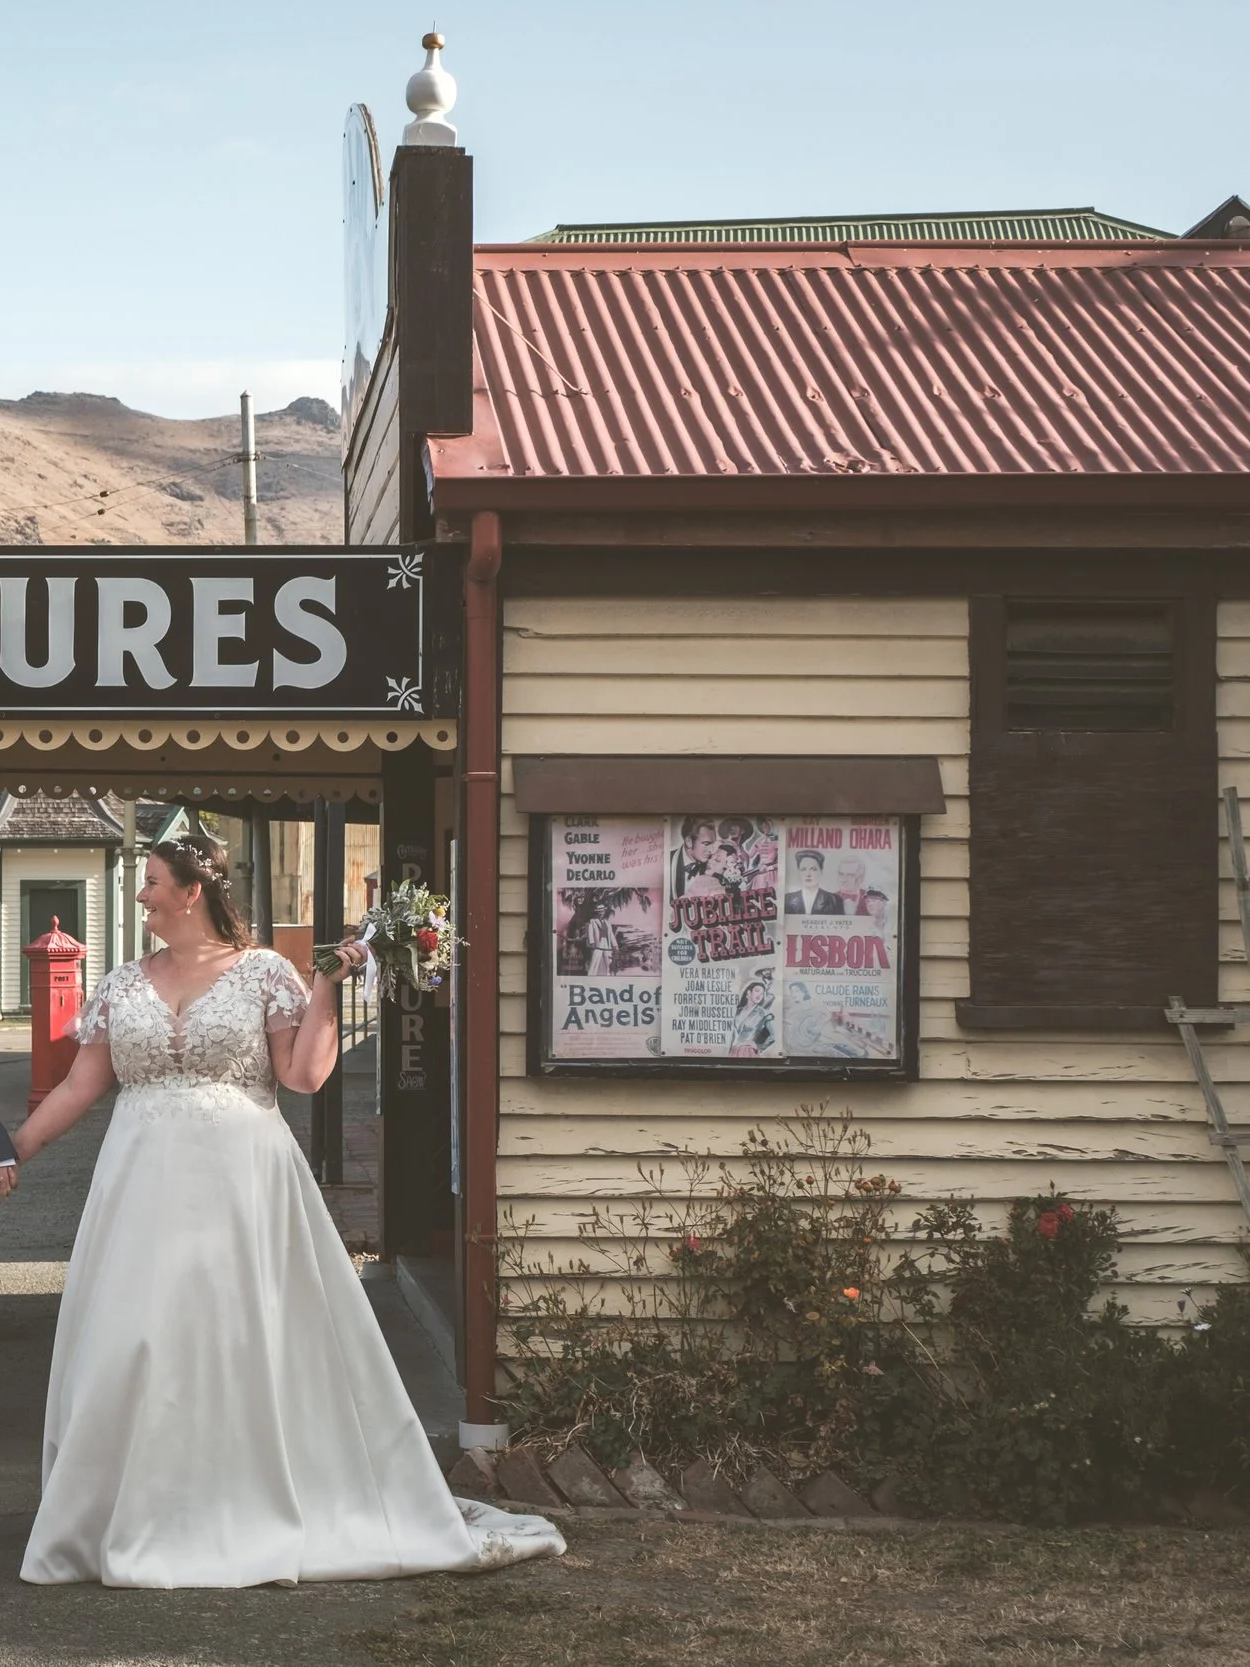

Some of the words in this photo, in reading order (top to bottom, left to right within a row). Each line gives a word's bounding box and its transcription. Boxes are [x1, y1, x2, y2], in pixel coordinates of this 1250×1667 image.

[564, 832, 600, 845] GABLE
[787, 827, 843, 849] MILLAND
[566, 851, 611, 865] YVONNE
[669, 887, 778, 933] JUBILEE
[690, 921, 774, 963] TRAIL
[400, 862, 425, 1071] PURE
[799, 969, 836, 977] NATURAMA
[845, 969, 882, 977] TRUCOLOR
[679, 967, 700, 980] VERA
[701, 967, 736, 980] RALSTON
[685, 980, 706, 993] JOAN
[707, 980, 733, 993] LESLIE
[815, 985, 850, 996] CLAUDE
[852, 985, 880, 996] RAINS
[673, 992, 708, 1005] FORREST
[710, 993, 742, 1006] TUCKER
[845, 996, 889, 1008] FURNEAUX
[678, 1006, 700, 1018] JOHN
[701, 1006, 735, 1019] RUSSELL
[671, 1018, 687, 1031] RAY
[688, 1018, 732, 1031] MIDDLETON
[680, 1032, 695, 1044] PAT
[696, 1032, 727, 1045] O'BRIEN
